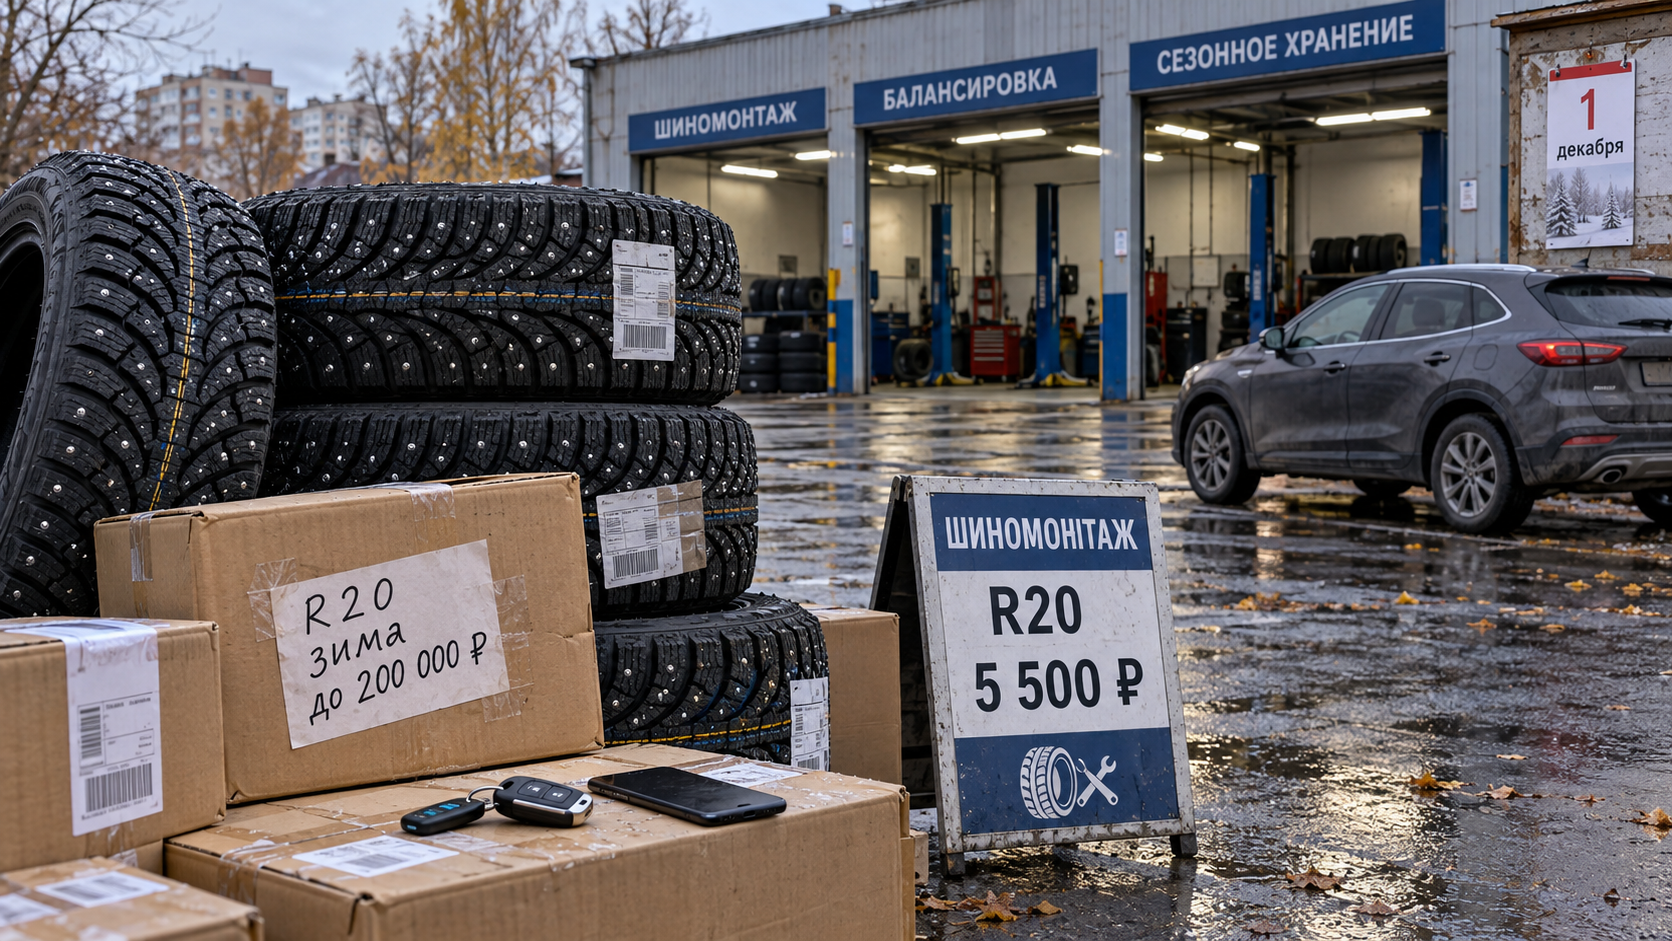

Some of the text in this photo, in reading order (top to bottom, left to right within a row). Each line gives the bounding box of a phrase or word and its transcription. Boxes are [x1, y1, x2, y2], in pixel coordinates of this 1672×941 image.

[1157, 14, 1413, 74] СЕЗОННОЕ ХРАНЕНИЕ
[884, 66, 1057, 110] БАЛАНСИРОВКА
[1580, 88, 1595, 130] 1
[655, 101, 797, 139] ШИНОМОНТАЖ
[1556, 137, 1624, 162] декабря
[989, 585, 1082, 636] R20
[310, 622, 406, 678] зима
[309, 687, 343, 726] до
